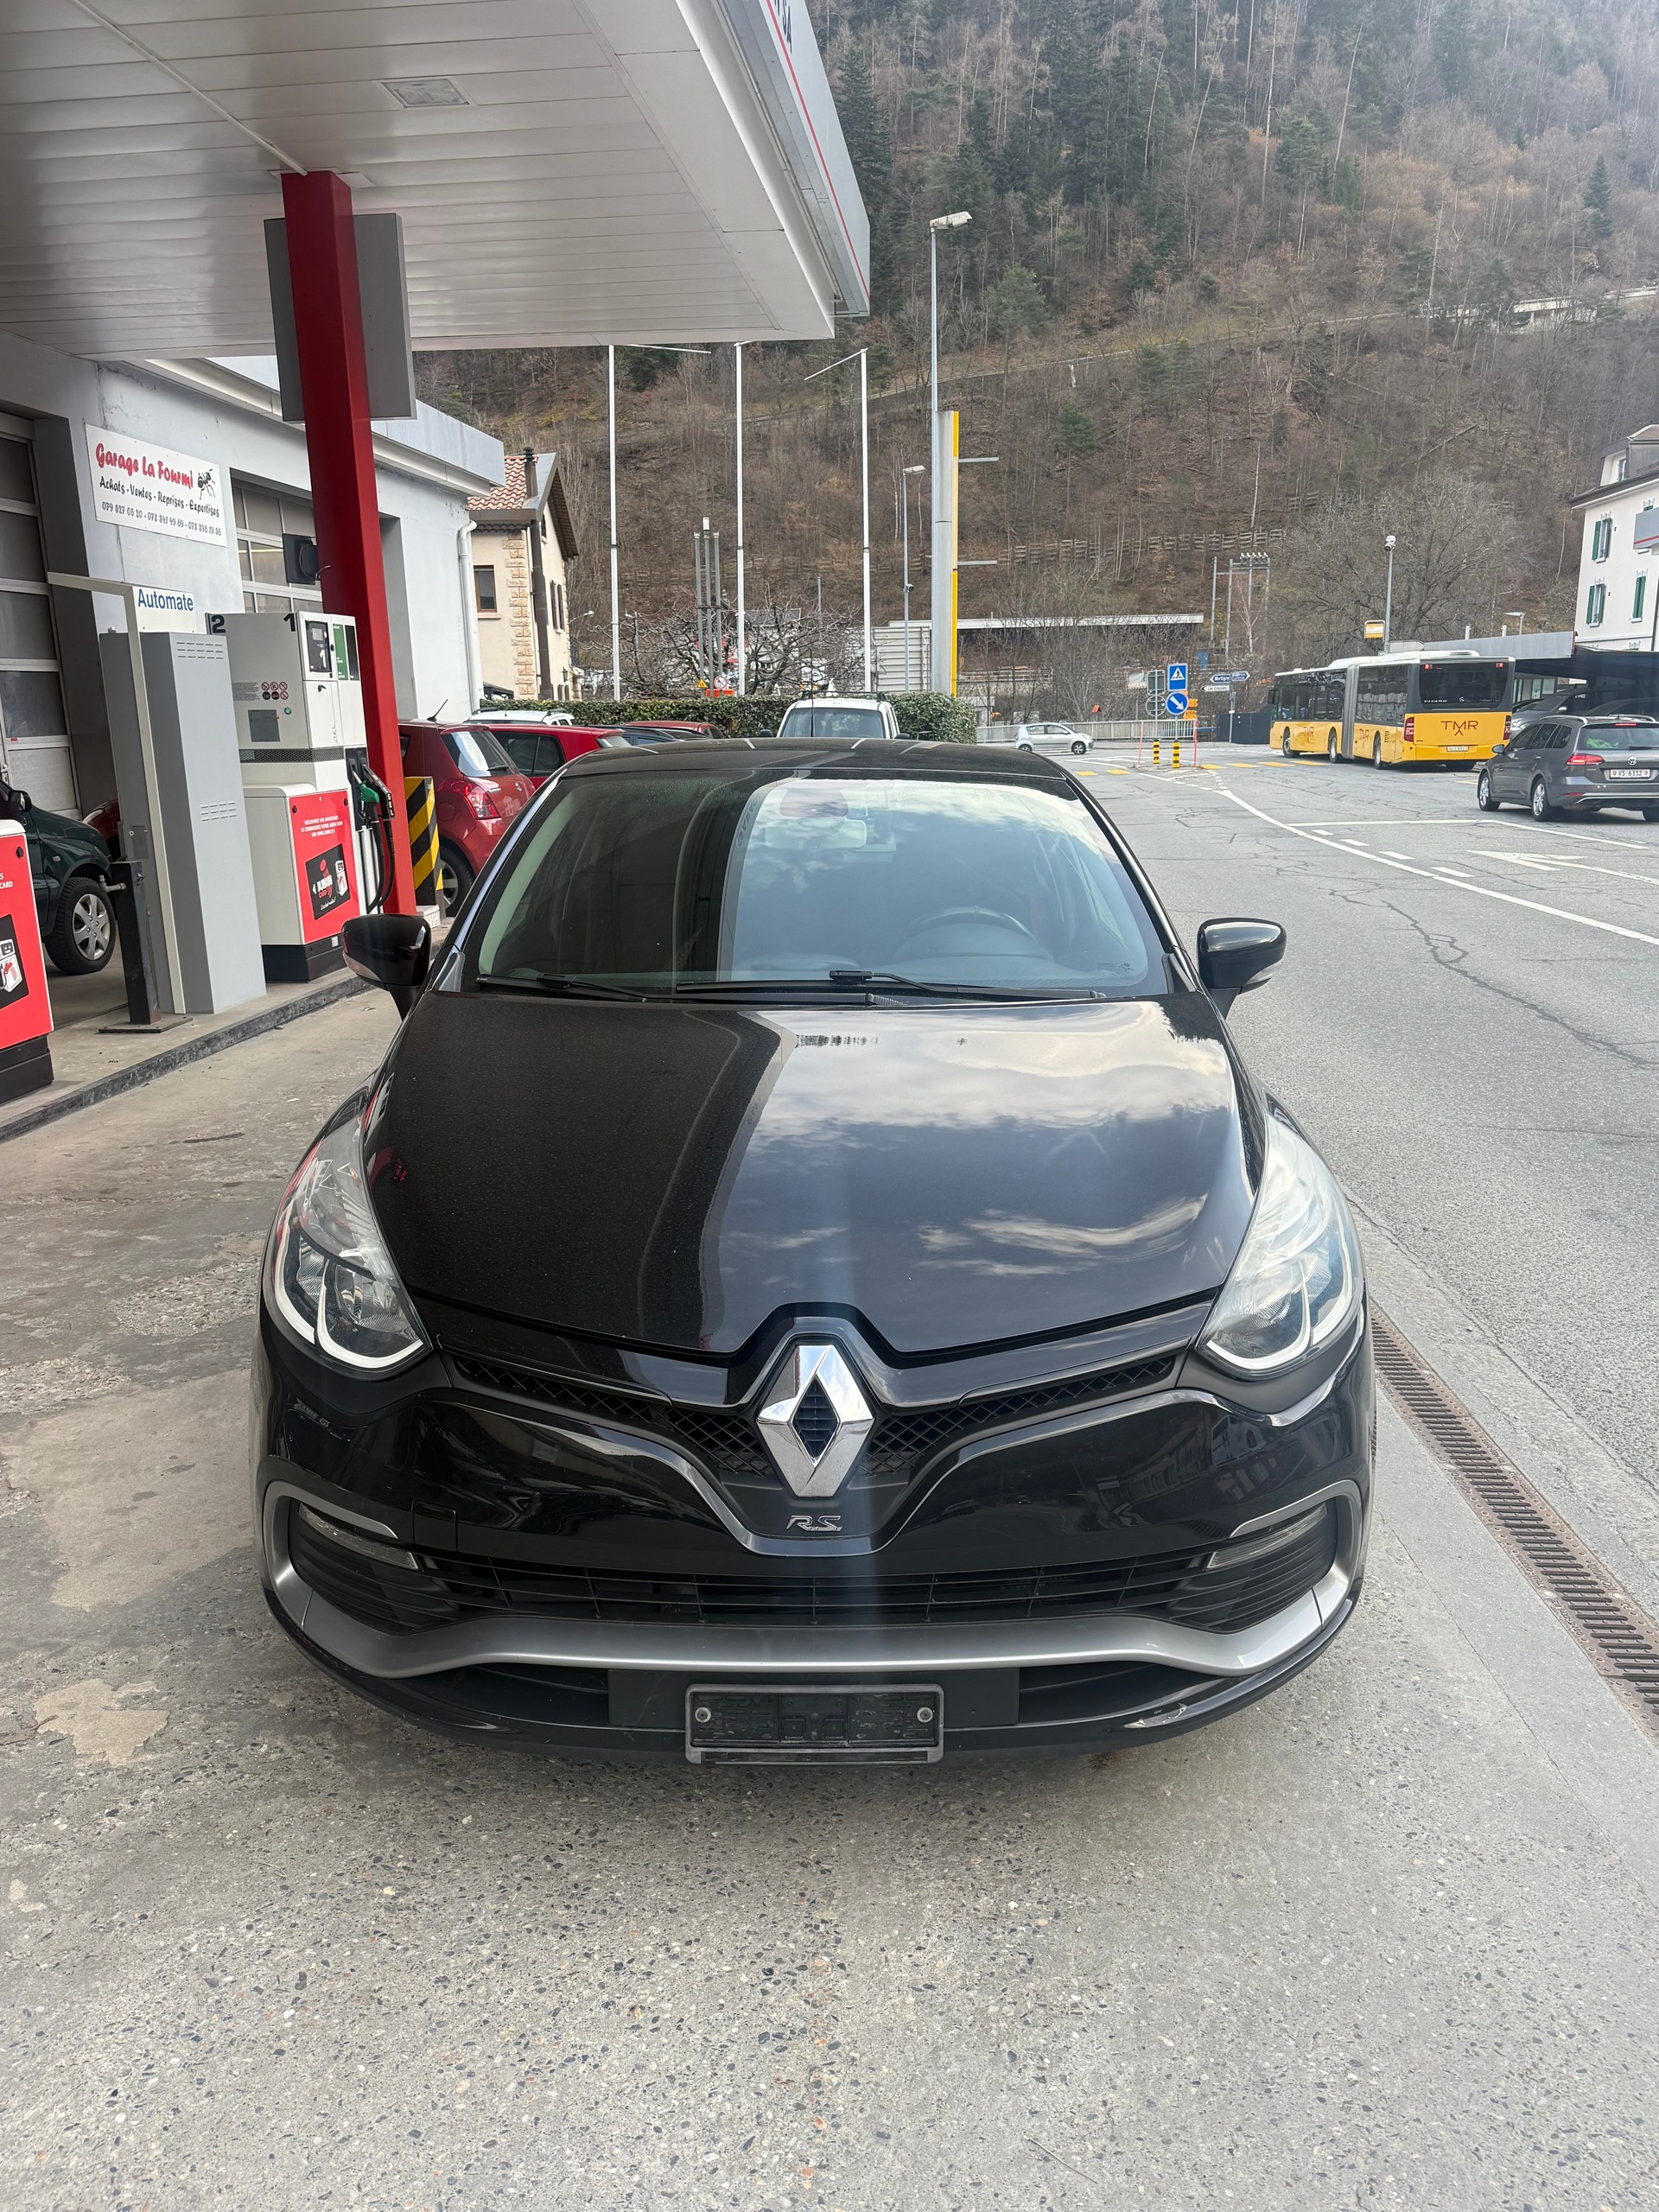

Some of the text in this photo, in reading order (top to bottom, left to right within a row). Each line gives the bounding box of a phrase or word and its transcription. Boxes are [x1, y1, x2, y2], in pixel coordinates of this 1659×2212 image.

[95, 442, 194, 489] Garage La Fourmi
[99, 476, 125, 494] Achats
[130, 484, 152, 501] Ventes
[157, 491, 185, 509] Reprises
[189, 499, 219, 518] Expertises
[137, 588, 194, 612] Automate
[211, 614, 226, 634] 2
[283, 613, 296, 632] 1
[319, 649, 327, 669] 1
[1440, 720, 1478, 736] TMR
